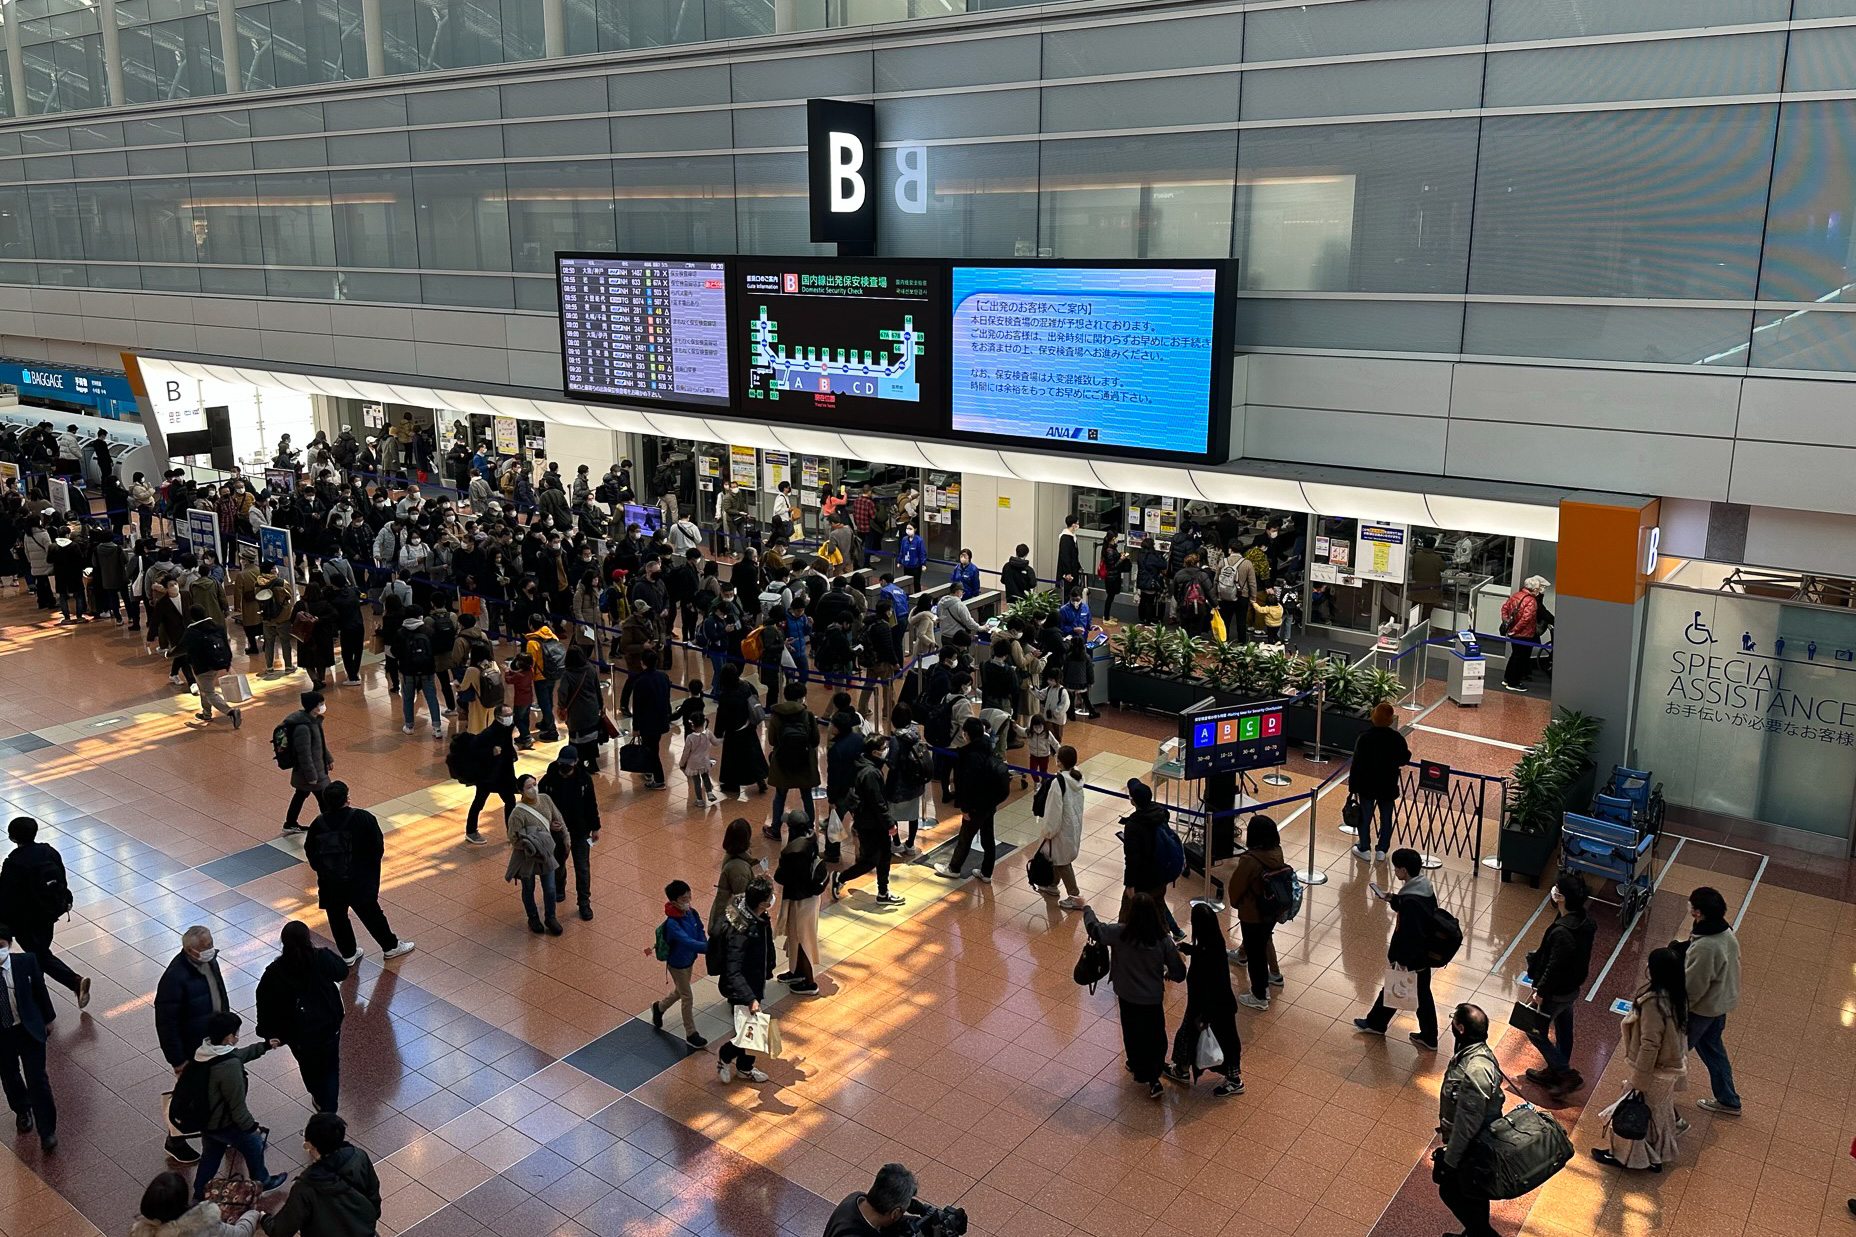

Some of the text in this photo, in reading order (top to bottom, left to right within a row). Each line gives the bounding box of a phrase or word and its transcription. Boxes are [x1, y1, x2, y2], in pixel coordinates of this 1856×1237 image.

[830, 132, 865, 212] B
[788, 276, 795, 290] B
[802, 274, 887, 288] 国内線出発保安検査場
[976, 300, 1092, 315] 【ご出発のお客様へご案内】
[971, 315, 1156, 332] 本日保安検査場の混雑が予想されております。
[971, 328, 1211, 349] ご出発のお客様は、出発時刻に関わらずお早めにお手続き
[971, 342, 1164, 362] をお済ませの上、保安検査場へお進みください。
[31, 371, 64, 388] BAGGAGE
[795, 377, 803, 388] A
[822, 380, 828, 390] B
[971, 368, 1124, 388] なお、保安検査場は大変混雑致します。
[166, 381, 181, 401] B
[853, 382, 861, 393] C
[866, 383, 874, 394] D
[970, 382, 1153, 404] 時間には余裕をもってお早めにご通過下さい。
[1046, 427, 1070, 438] ANA
[1646, 526, 1660, 576] B
[1670, 650, 1791, 692] SPECIAL
[1667, 675, 1856, 728] ASSISTANCE
[1224, 725, 1231, 734] B
[1247, 721, 1253, 730] C
[1269, 718, 1275, 727] D
[1665, 700, 1855, 747] お手伝いが必要なお客様
[1201, 728, 1208, 737] A
